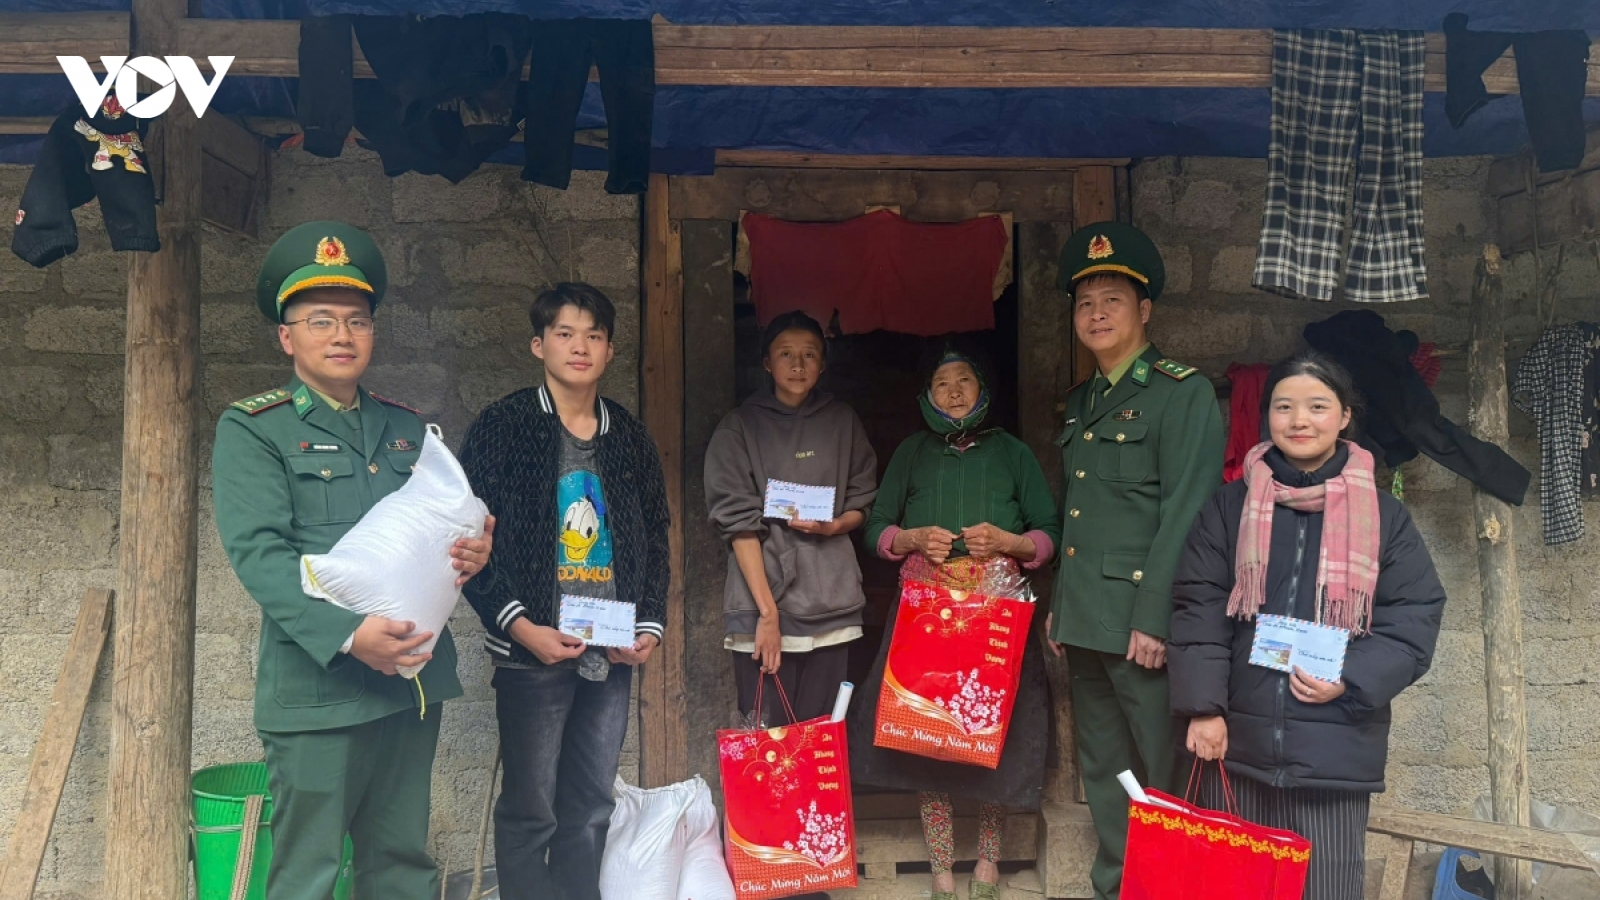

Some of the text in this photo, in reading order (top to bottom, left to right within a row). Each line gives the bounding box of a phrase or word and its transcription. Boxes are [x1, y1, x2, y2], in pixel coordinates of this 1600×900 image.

[557, 565, 613, 582] DONALD
[881, 722, 909, 738] Chúc
[740, 880, 767, 892] Chúc
